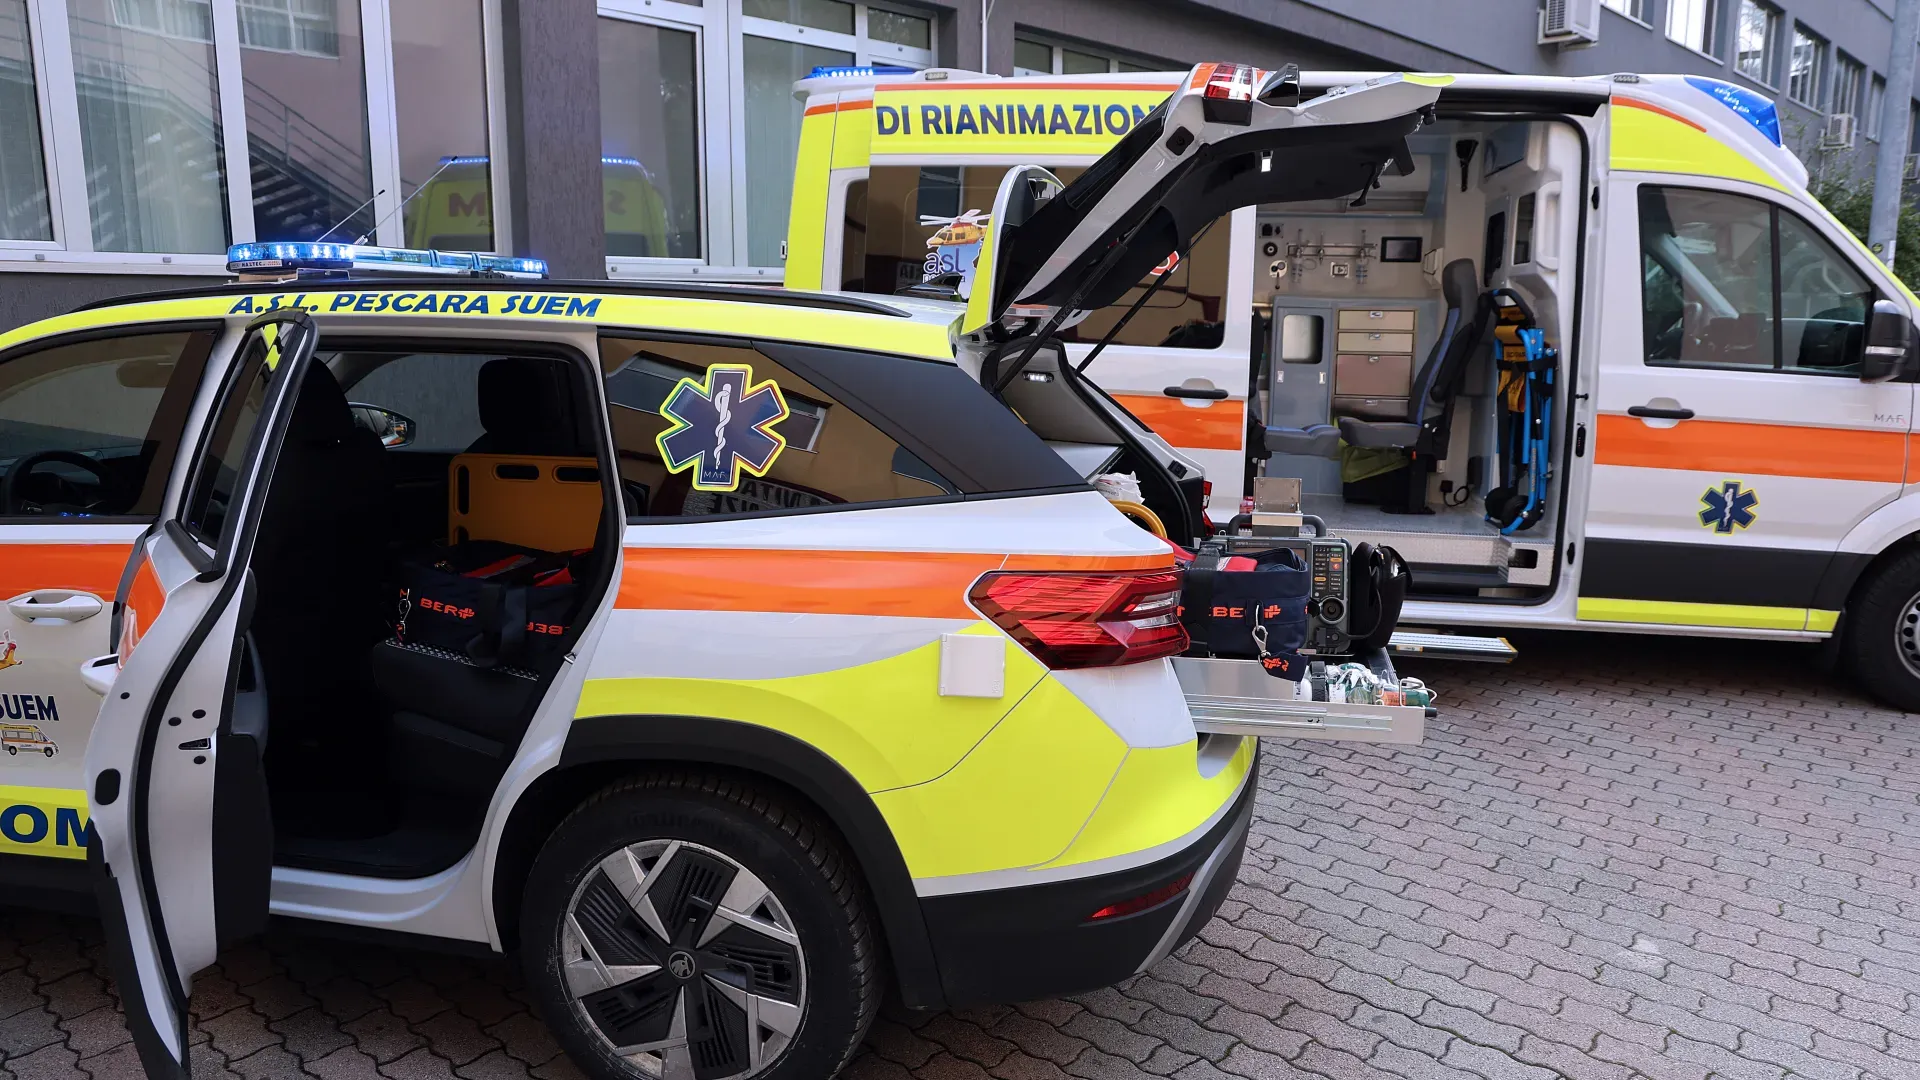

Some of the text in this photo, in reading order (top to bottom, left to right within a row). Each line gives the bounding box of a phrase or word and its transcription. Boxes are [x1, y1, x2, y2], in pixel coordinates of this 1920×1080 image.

[875, 104, 911, 136] DI
[924, 247, 966, 273] asl
[228, 293, 602, 317] A.S.L. PESCARA SUEM
